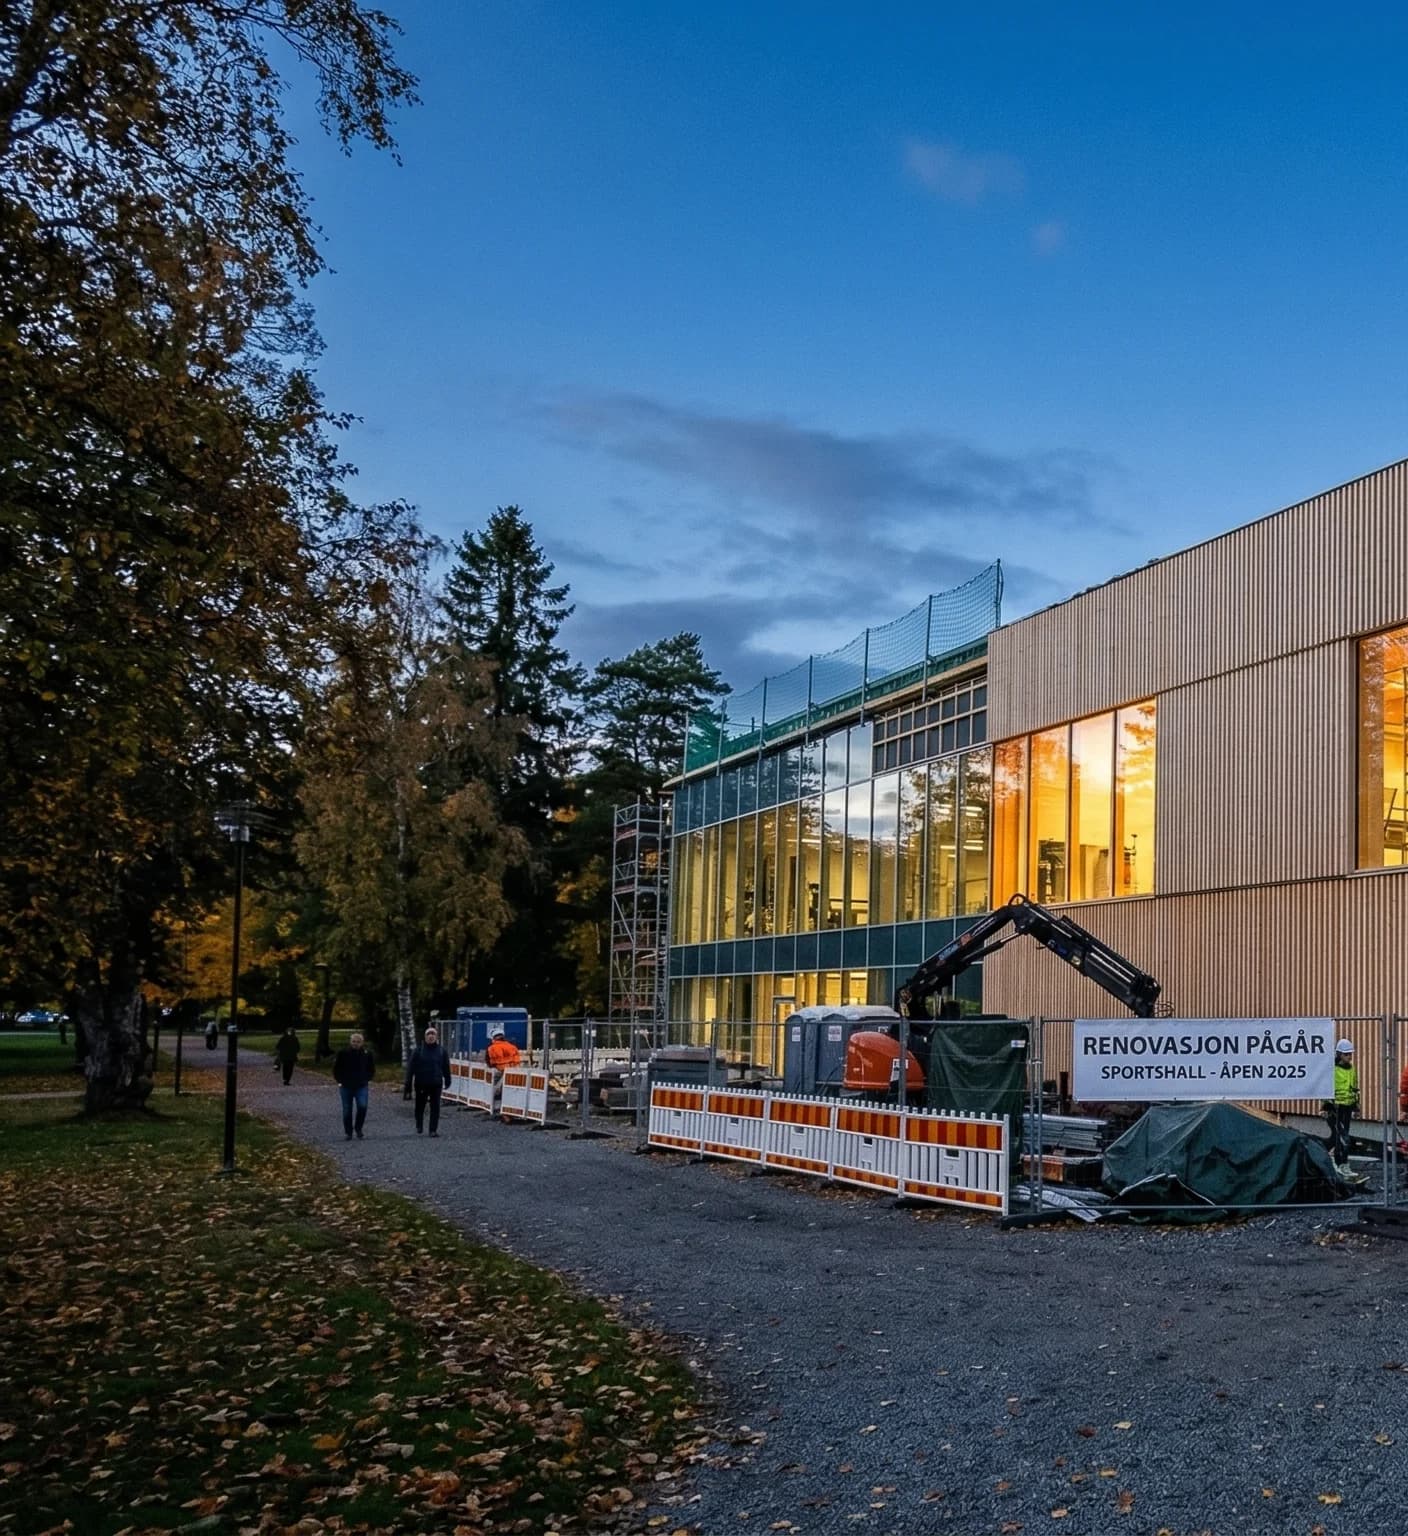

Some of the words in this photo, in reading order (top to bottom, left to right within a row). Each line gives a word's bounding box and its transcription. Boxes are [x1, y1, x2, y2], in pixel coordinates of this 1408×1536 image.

[1083, 1036, 1239, 1055] RENOVASJON
[1247, 1030, 1325, 1054] PÅGÅR
[1101, 1065, 1206, 1079] SPORTSHALL
[1220, 1061, 1263, 1079] ÅPEN
[1268, 1065, 1306, 1079] 2025
